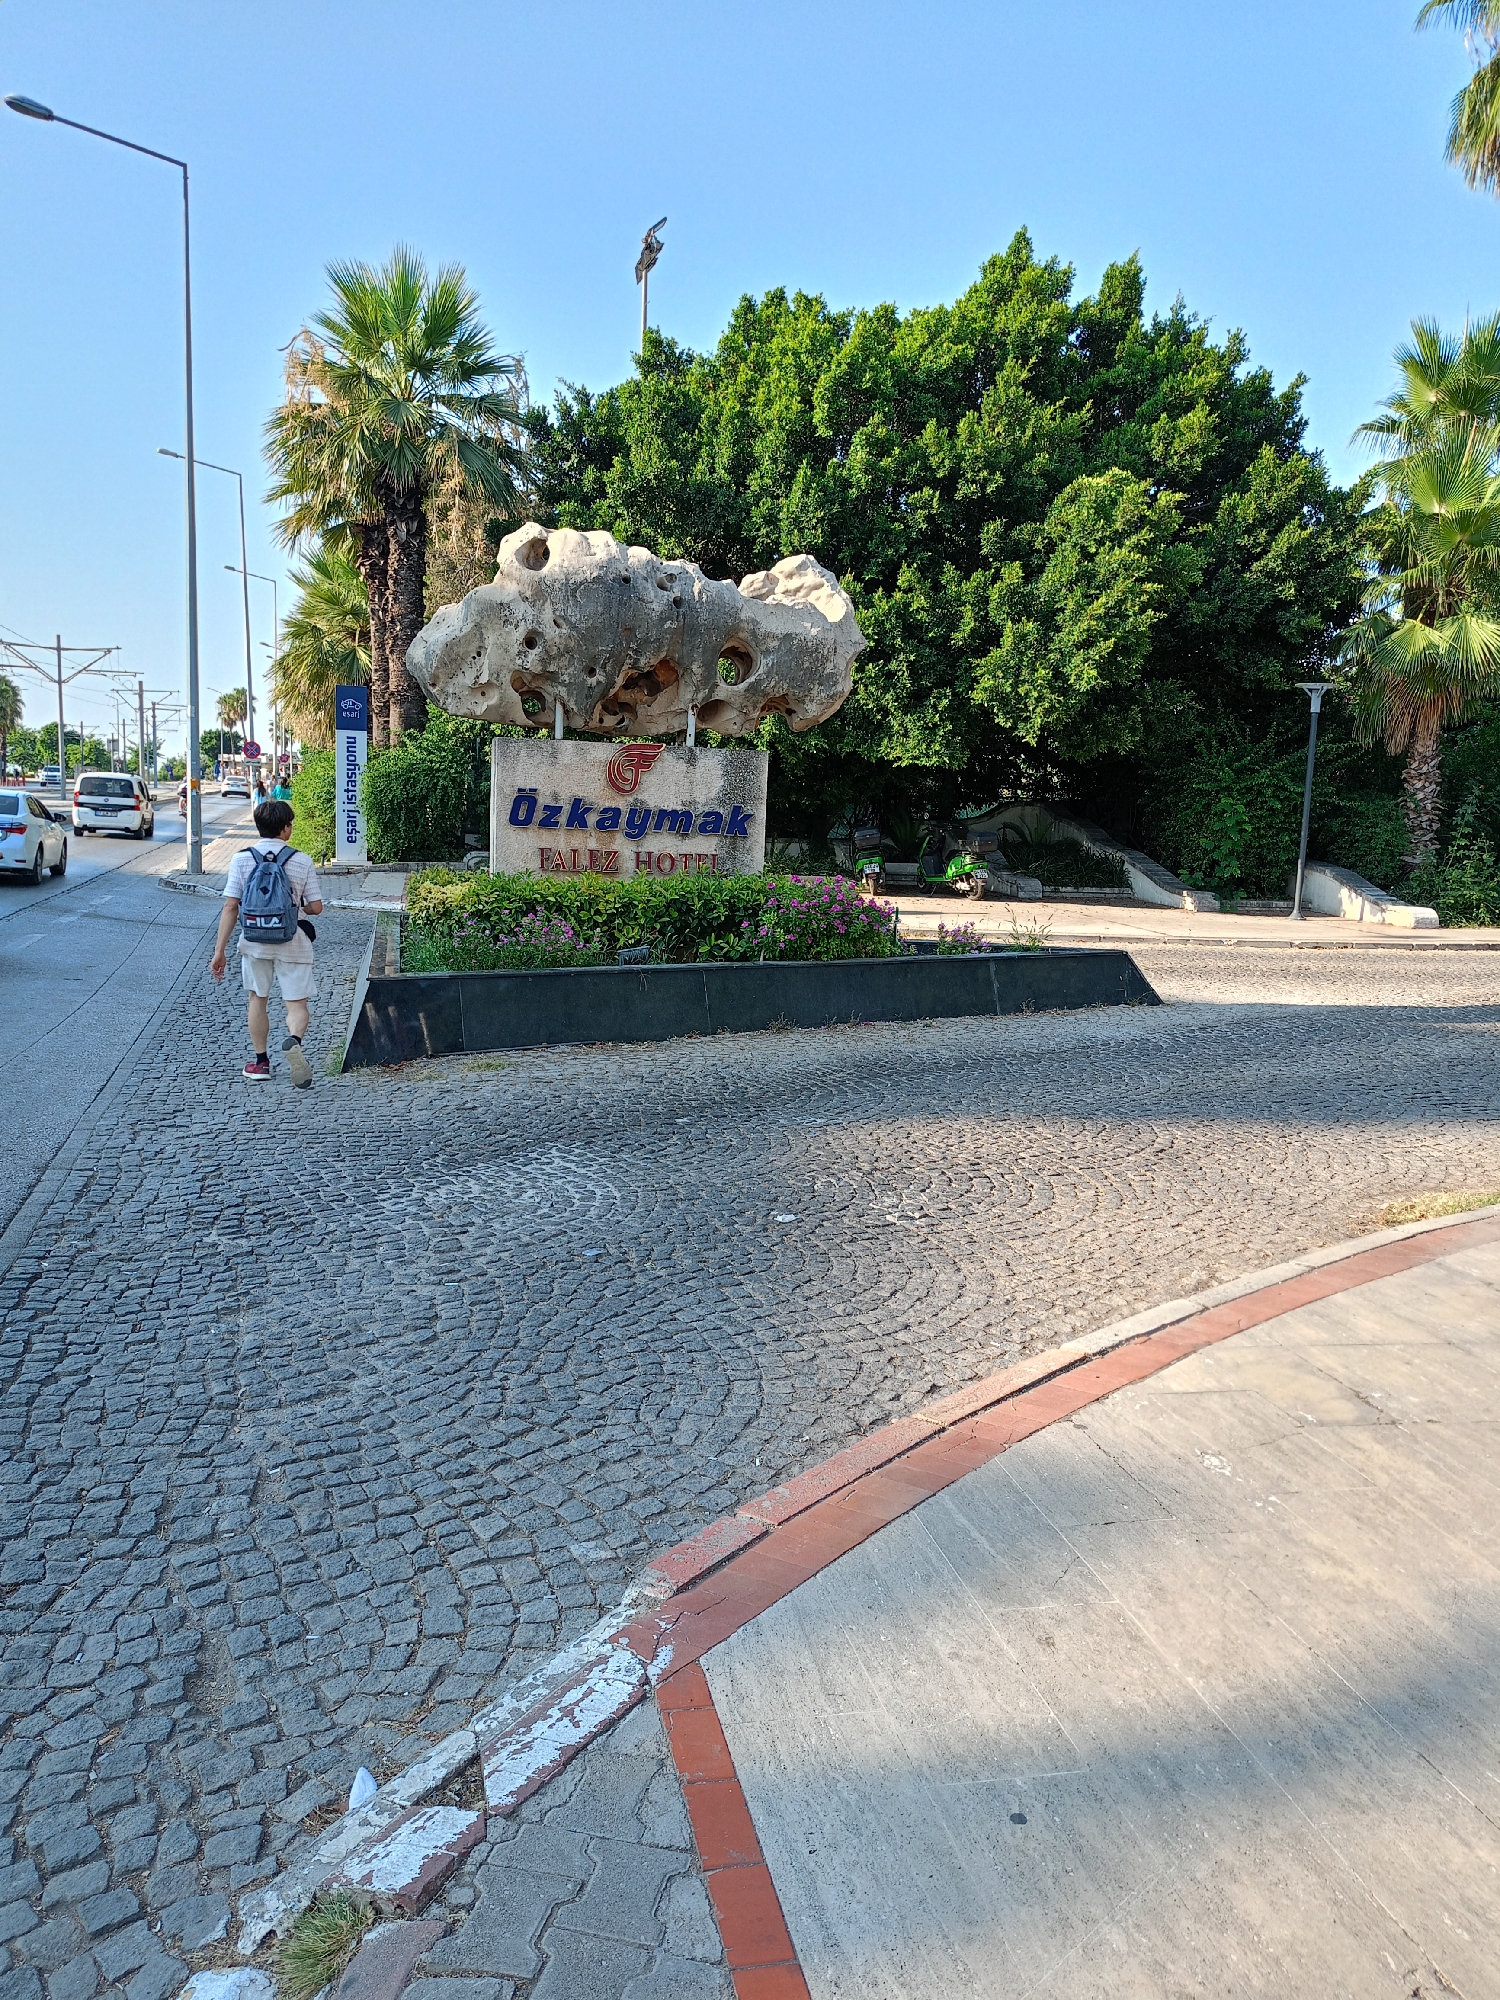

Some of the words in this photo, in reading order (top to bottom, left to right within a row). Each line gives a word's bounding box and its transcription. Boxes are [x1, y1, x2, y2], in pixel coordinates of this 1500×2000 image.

[342, 736, 360, 805] istasyonu
[342, 809, 360, 844] eşarj
[508, 788, 755, 841] Özkaymak
[538, 847, 620, 873] FALEZ
[246, 915, 282, 928] FILA
